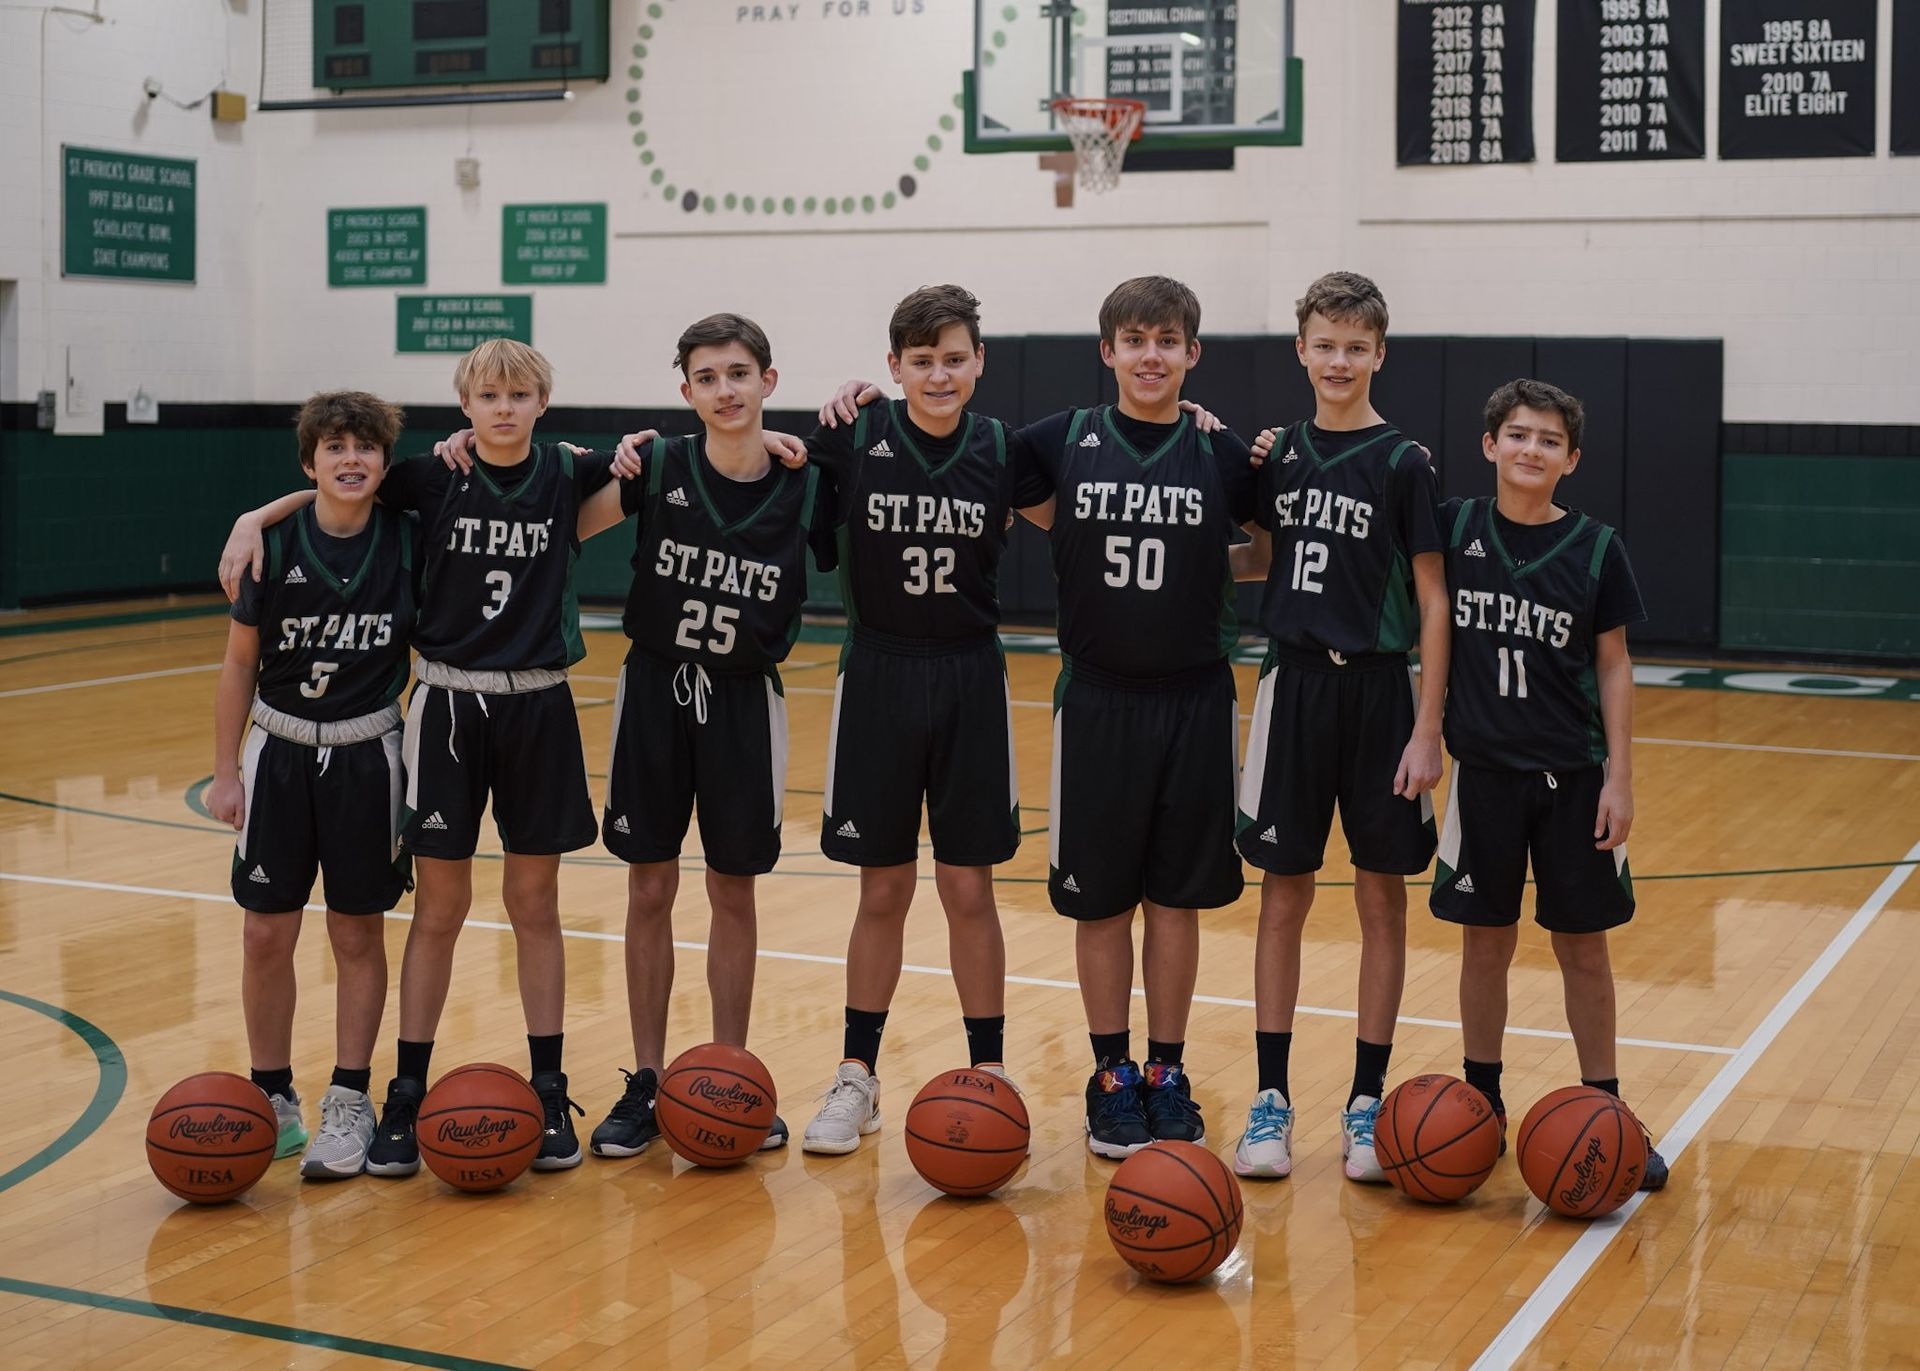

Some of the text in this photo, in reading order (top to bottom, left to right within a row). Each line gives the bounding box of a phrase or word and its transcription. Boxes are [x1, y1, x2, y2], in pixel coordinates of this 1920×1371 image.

[737, 0, 925, 22] PRAY FOR US
[1432, 4, 1505, 28] 2012 8A
[1601, 0, 1669, 20] 1995 8A
[1432, 27, 1505, 51] 2015 8A
[1600, 23, 1669, 47] 2003 7A
[1762, 19, 1832, 43] 1995 8A
[1433, 50, 1503, 73] 2017 7A
[1600, 50, 1668, 73] 2004 7A
[1730, 39, 1865, 66] SWEET SIXTEEN
[1482, 72, 1503, 94] 7A
[1600, 76, 1668, 100] 2007 7A
[1761, 71, 1831, 94] 2010 7A
[1480, 95, 1504, 116] 8A
[1600, 103, 1668, 126] 2010 7A
[1745, 91, 1848, 117] ELITE EIGHT
[1481, 117, 1502, 139] 7A
[1479, 139, 1503, 162] 8A
[1600, 129, 1667, 152] 2011 7A
[159, 167, 192, 189] SCHOOL
[136, 193, 164, 213] CLASS
[166, 197, 174, 215] A
[93, 218, 145, 241] SCHOLASTIC
[93, 248, 169, 271] STATE CHAMPIONS
[902, 546, 957, 595] 32
[1104, 535, 1165, 591] 50
[1291, 540, 1329, 595] 12
[482, 569, 512, 620] 3
[675, 599, 740, 655] 25
[300, 661, 339, 699] 5
[1498, 647, 1527, 699] 11
[689, 1076, 762, 1113] Rawlings
[952, 1075, 996, 1096] IESA
[170, 1113, 253, 1143] Rawlings
[438, 1115, 518, 1142] Rawlings
[694, 1127, 737, 1151] IESA
[187, 1168, 234, 1184] IESA
[1561, 1137, 1607, 1209] Rawlings
[1107, 1198, 1169, 1239] Rawlings
